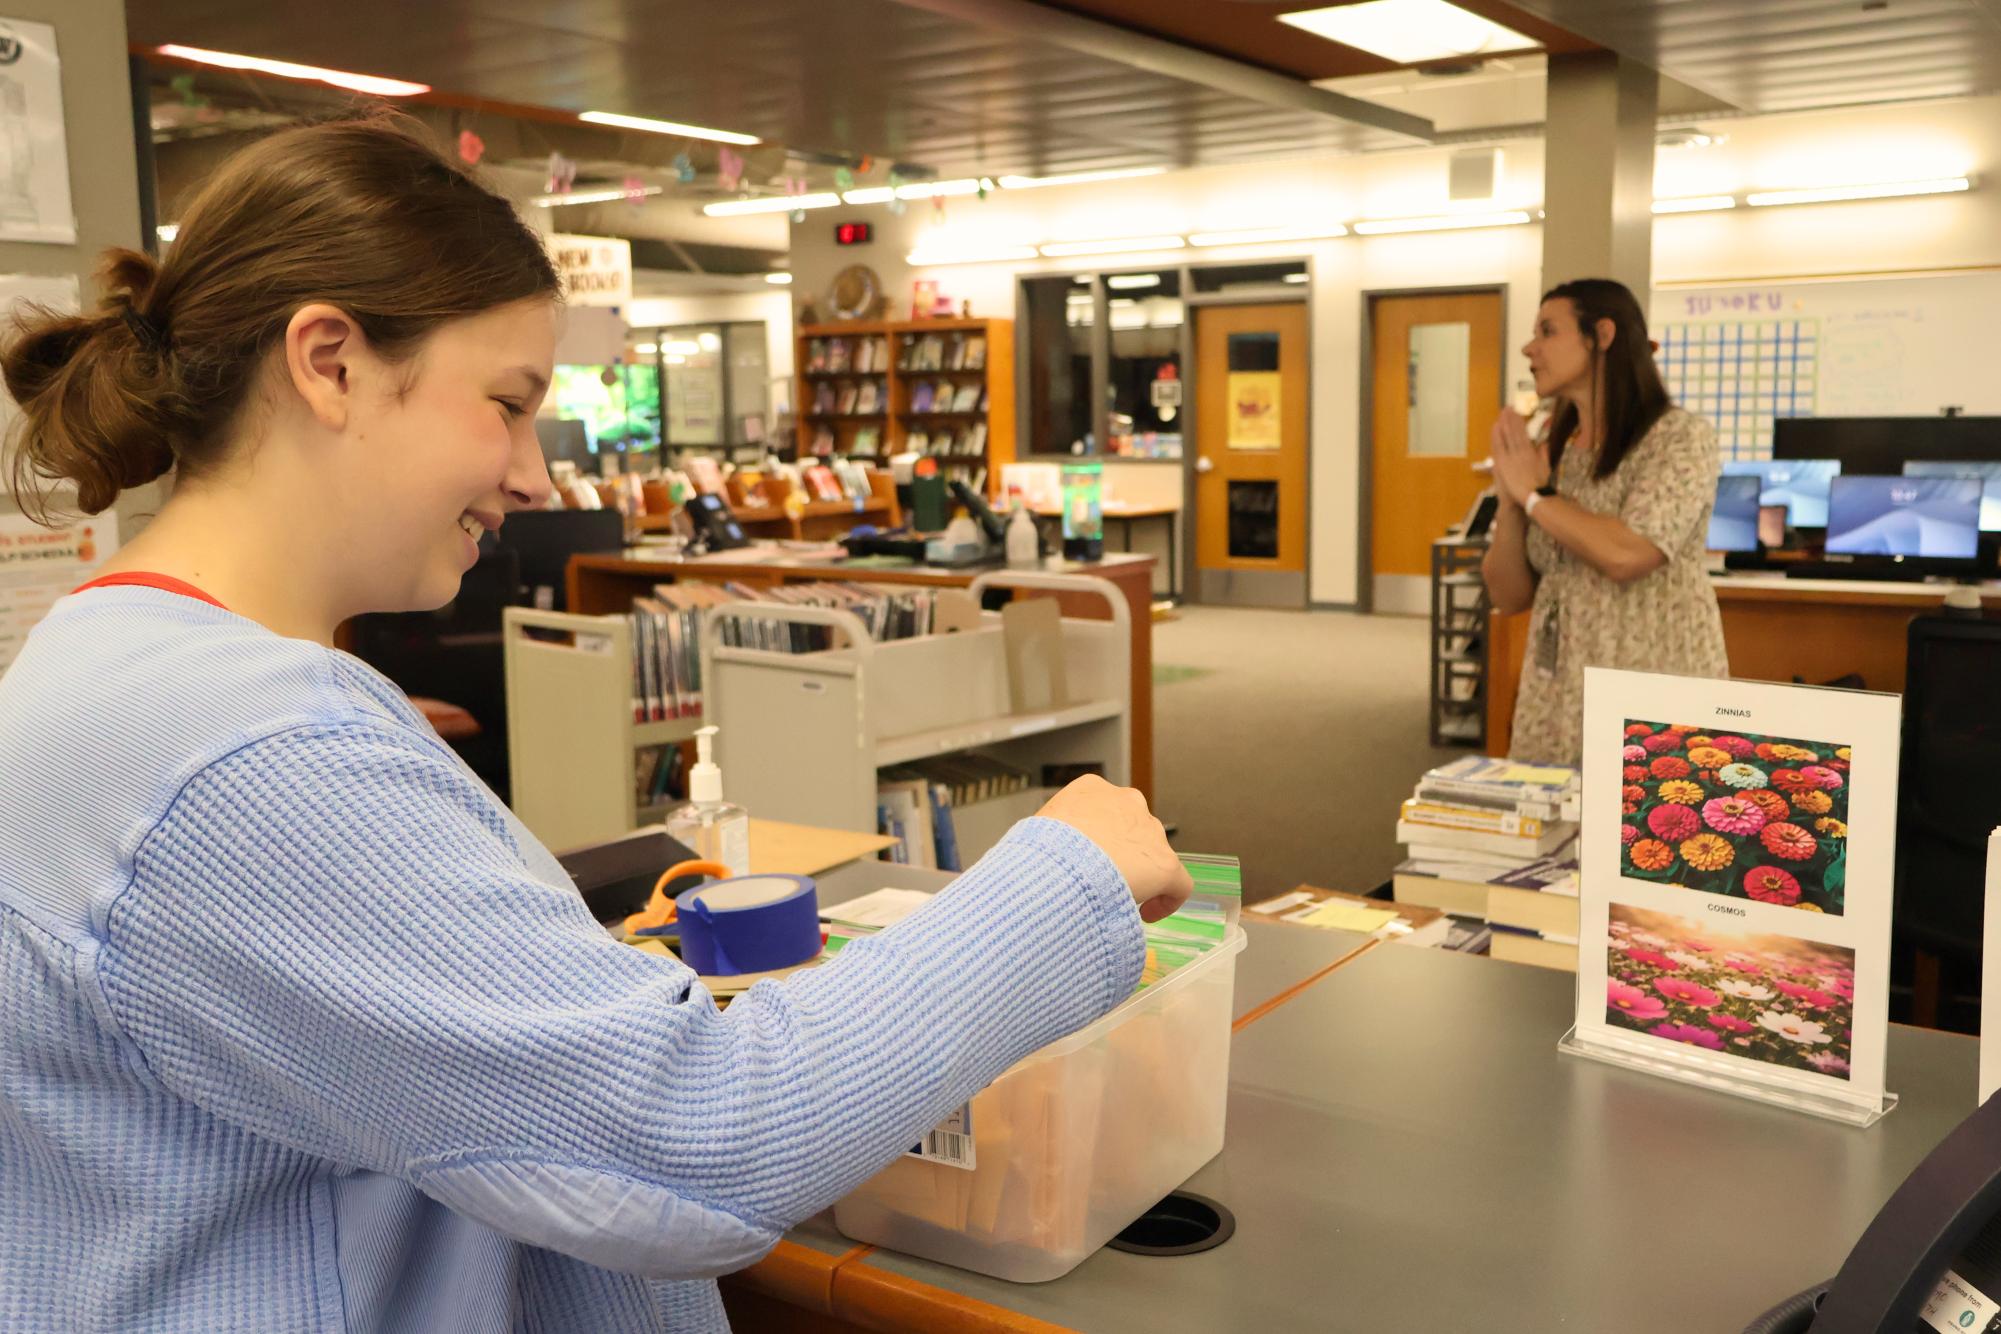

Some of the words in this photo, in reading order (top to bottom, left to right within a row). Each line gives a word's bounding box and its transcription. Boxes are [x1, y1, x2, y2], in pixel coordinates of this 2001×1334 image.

[1715, 707, 1752, 718] ZINNIAS
[1707, 903, 1747, 917] COSMOS
[1968, 1294, 1983, 1310] from
